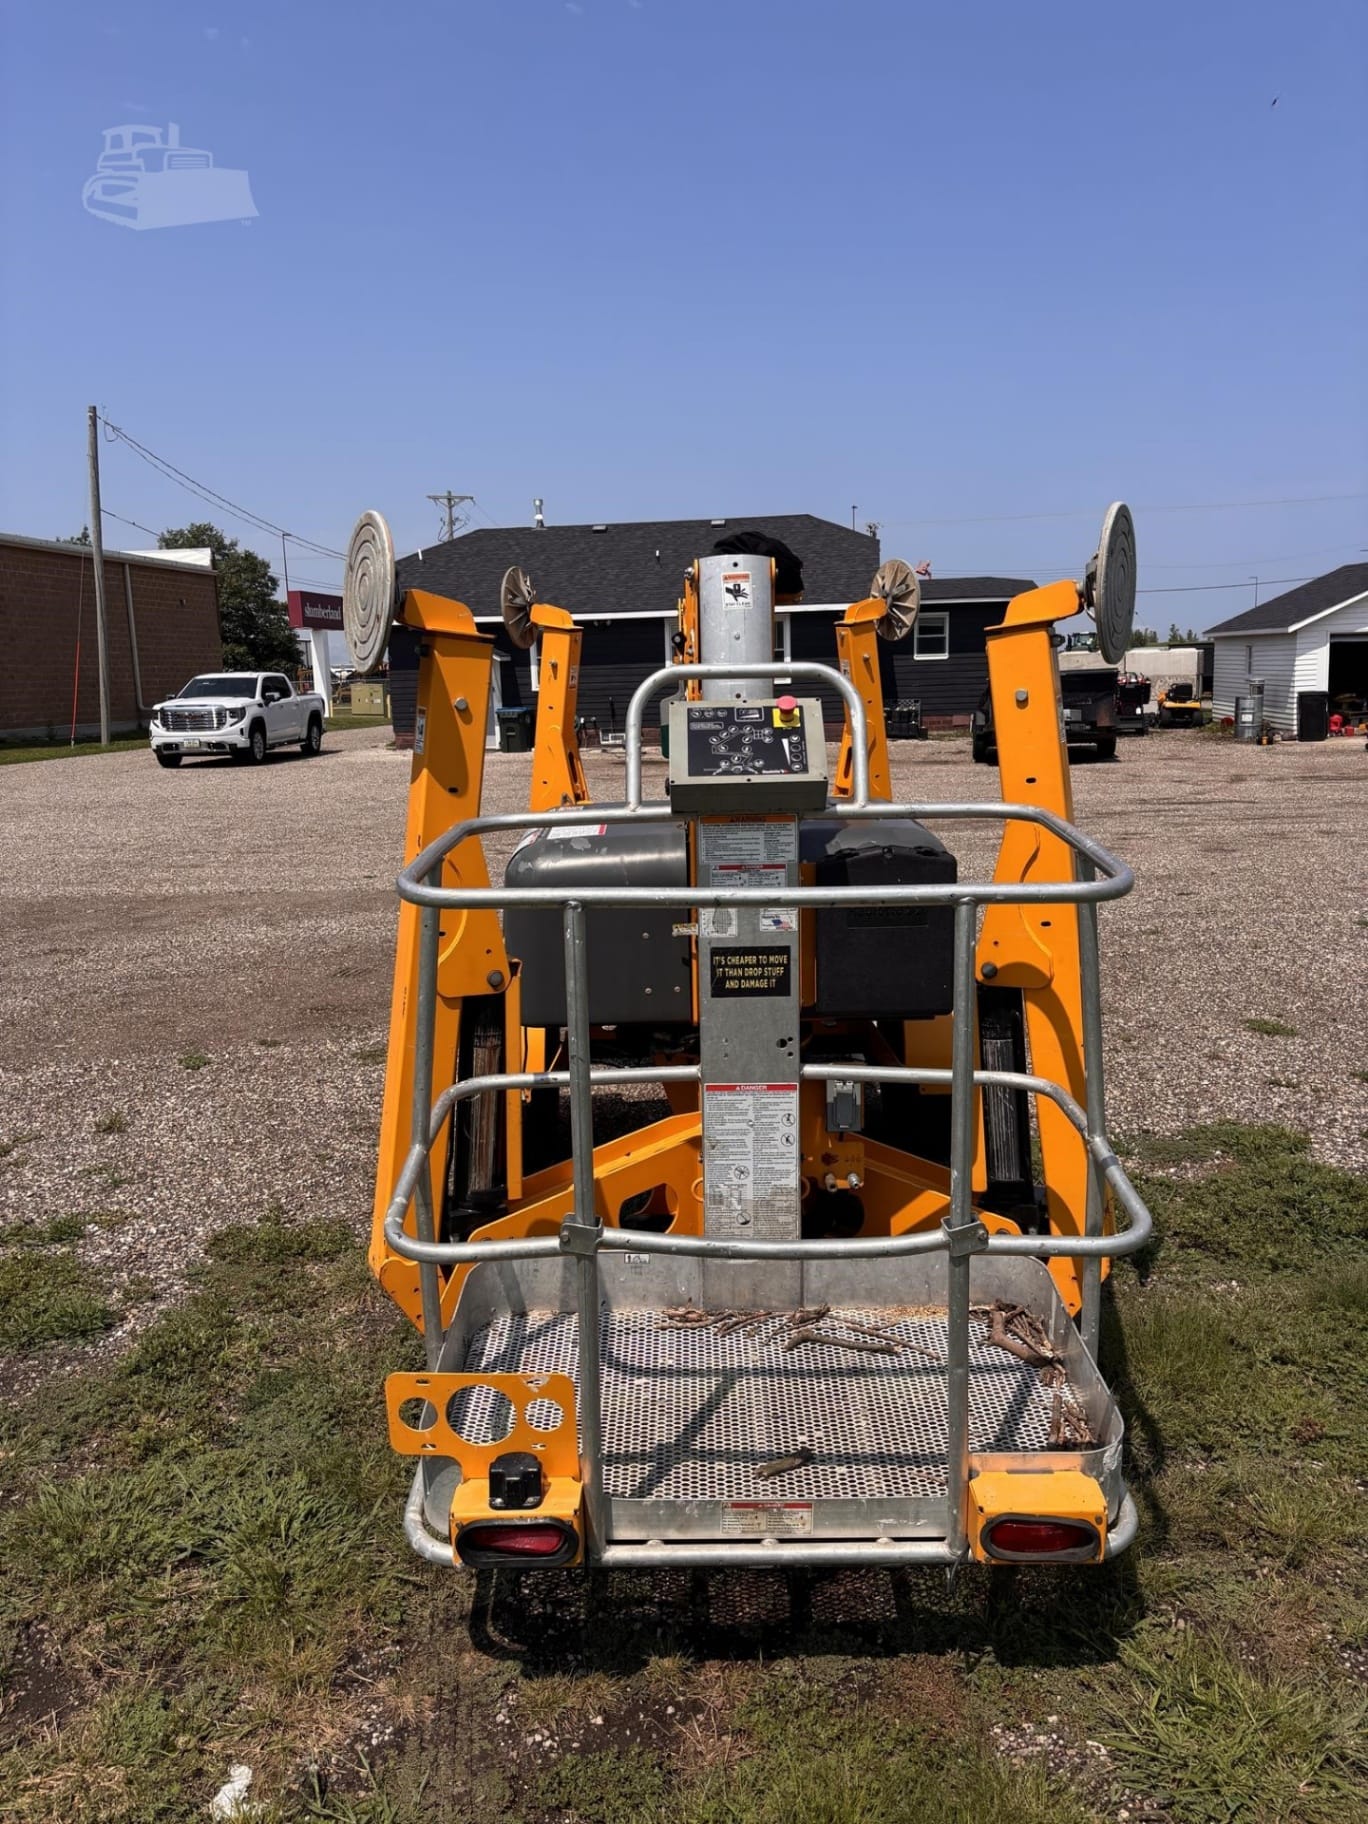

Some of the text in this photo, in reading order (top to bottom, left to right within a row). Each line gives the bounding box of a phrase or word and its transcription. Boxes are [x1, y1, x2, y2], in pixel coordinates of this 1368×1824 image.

[713, 955, 788, 965] IT'S CHEAPER TO MOVE
[716, 967, 784, 977] IT THAN DROP STUFF
[725, 979, 776, 989] AND DAMAGE IT
